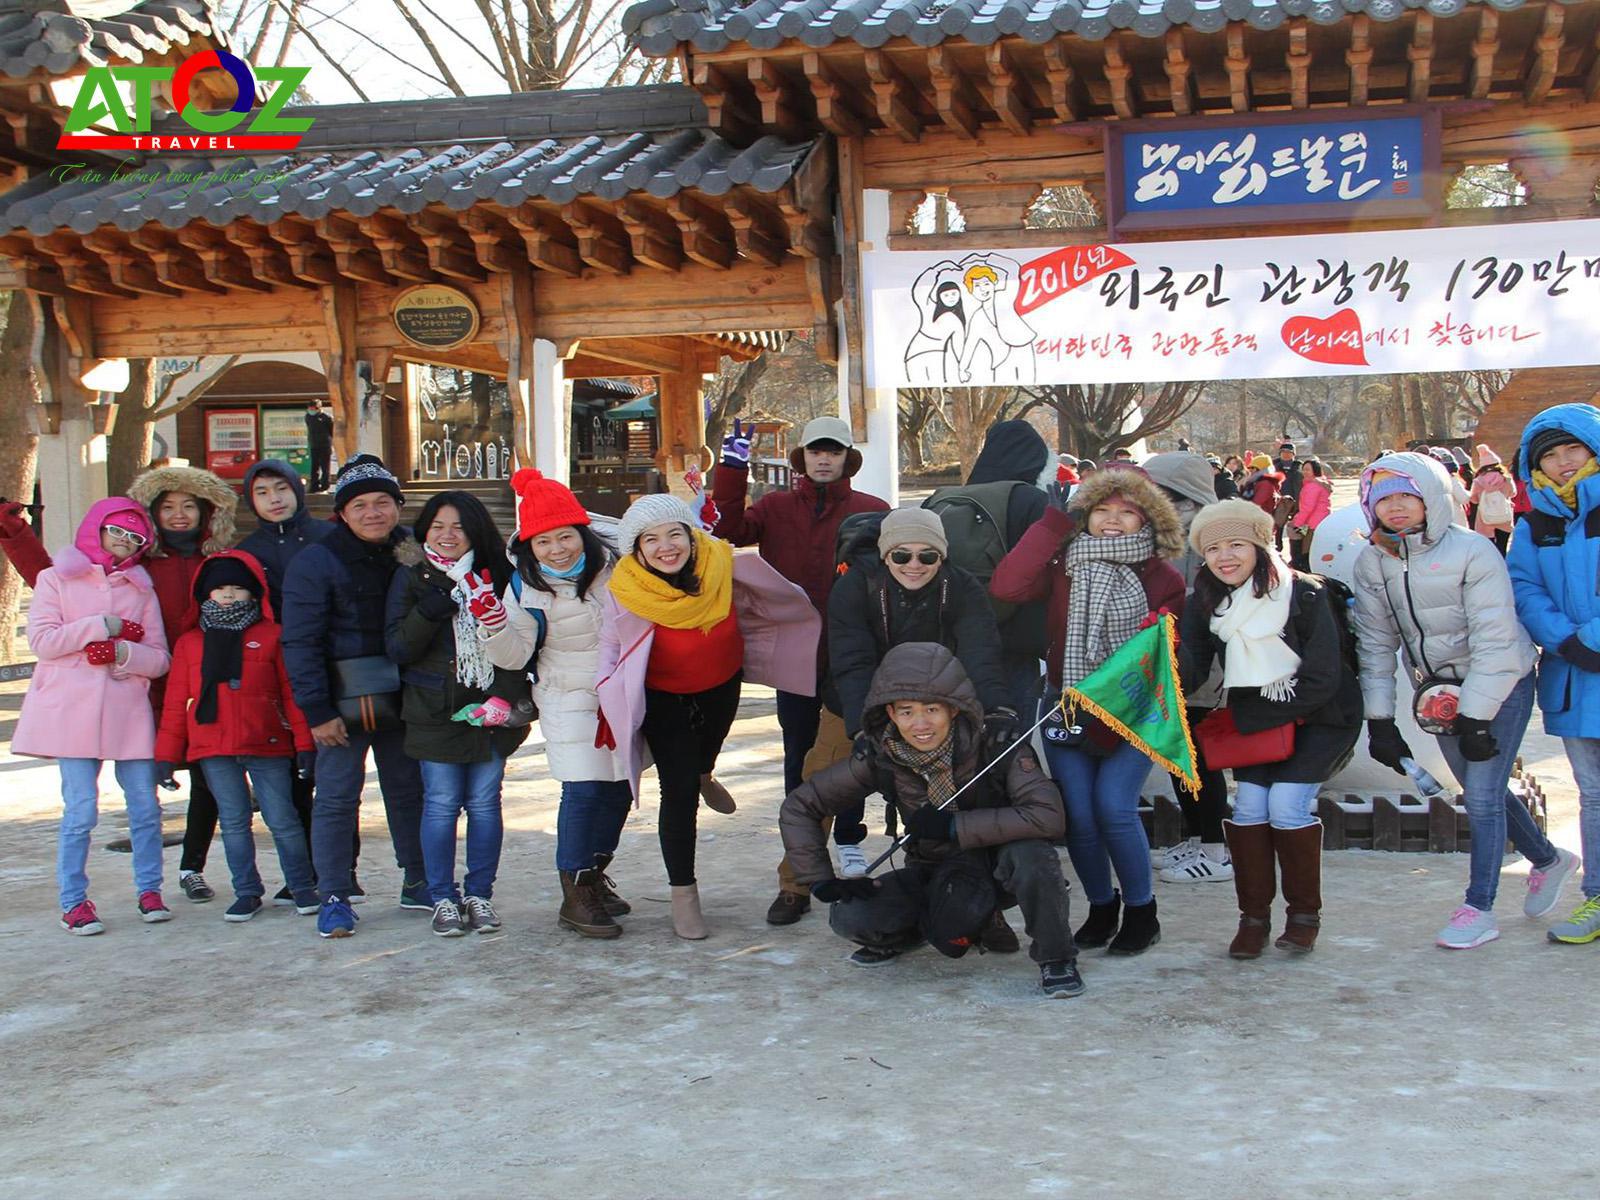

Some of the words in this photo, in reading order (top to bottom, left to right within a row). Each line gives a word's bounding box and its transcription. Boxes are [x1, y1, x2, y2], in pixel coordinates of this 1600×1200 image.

[1020, 245, 1114, 308] 2016년
[1100, 263, 1231, 311] 외국인
[1260, 255, 1411, 306] 관광객
[1427, 312, 1543, 348] 찾습니다
